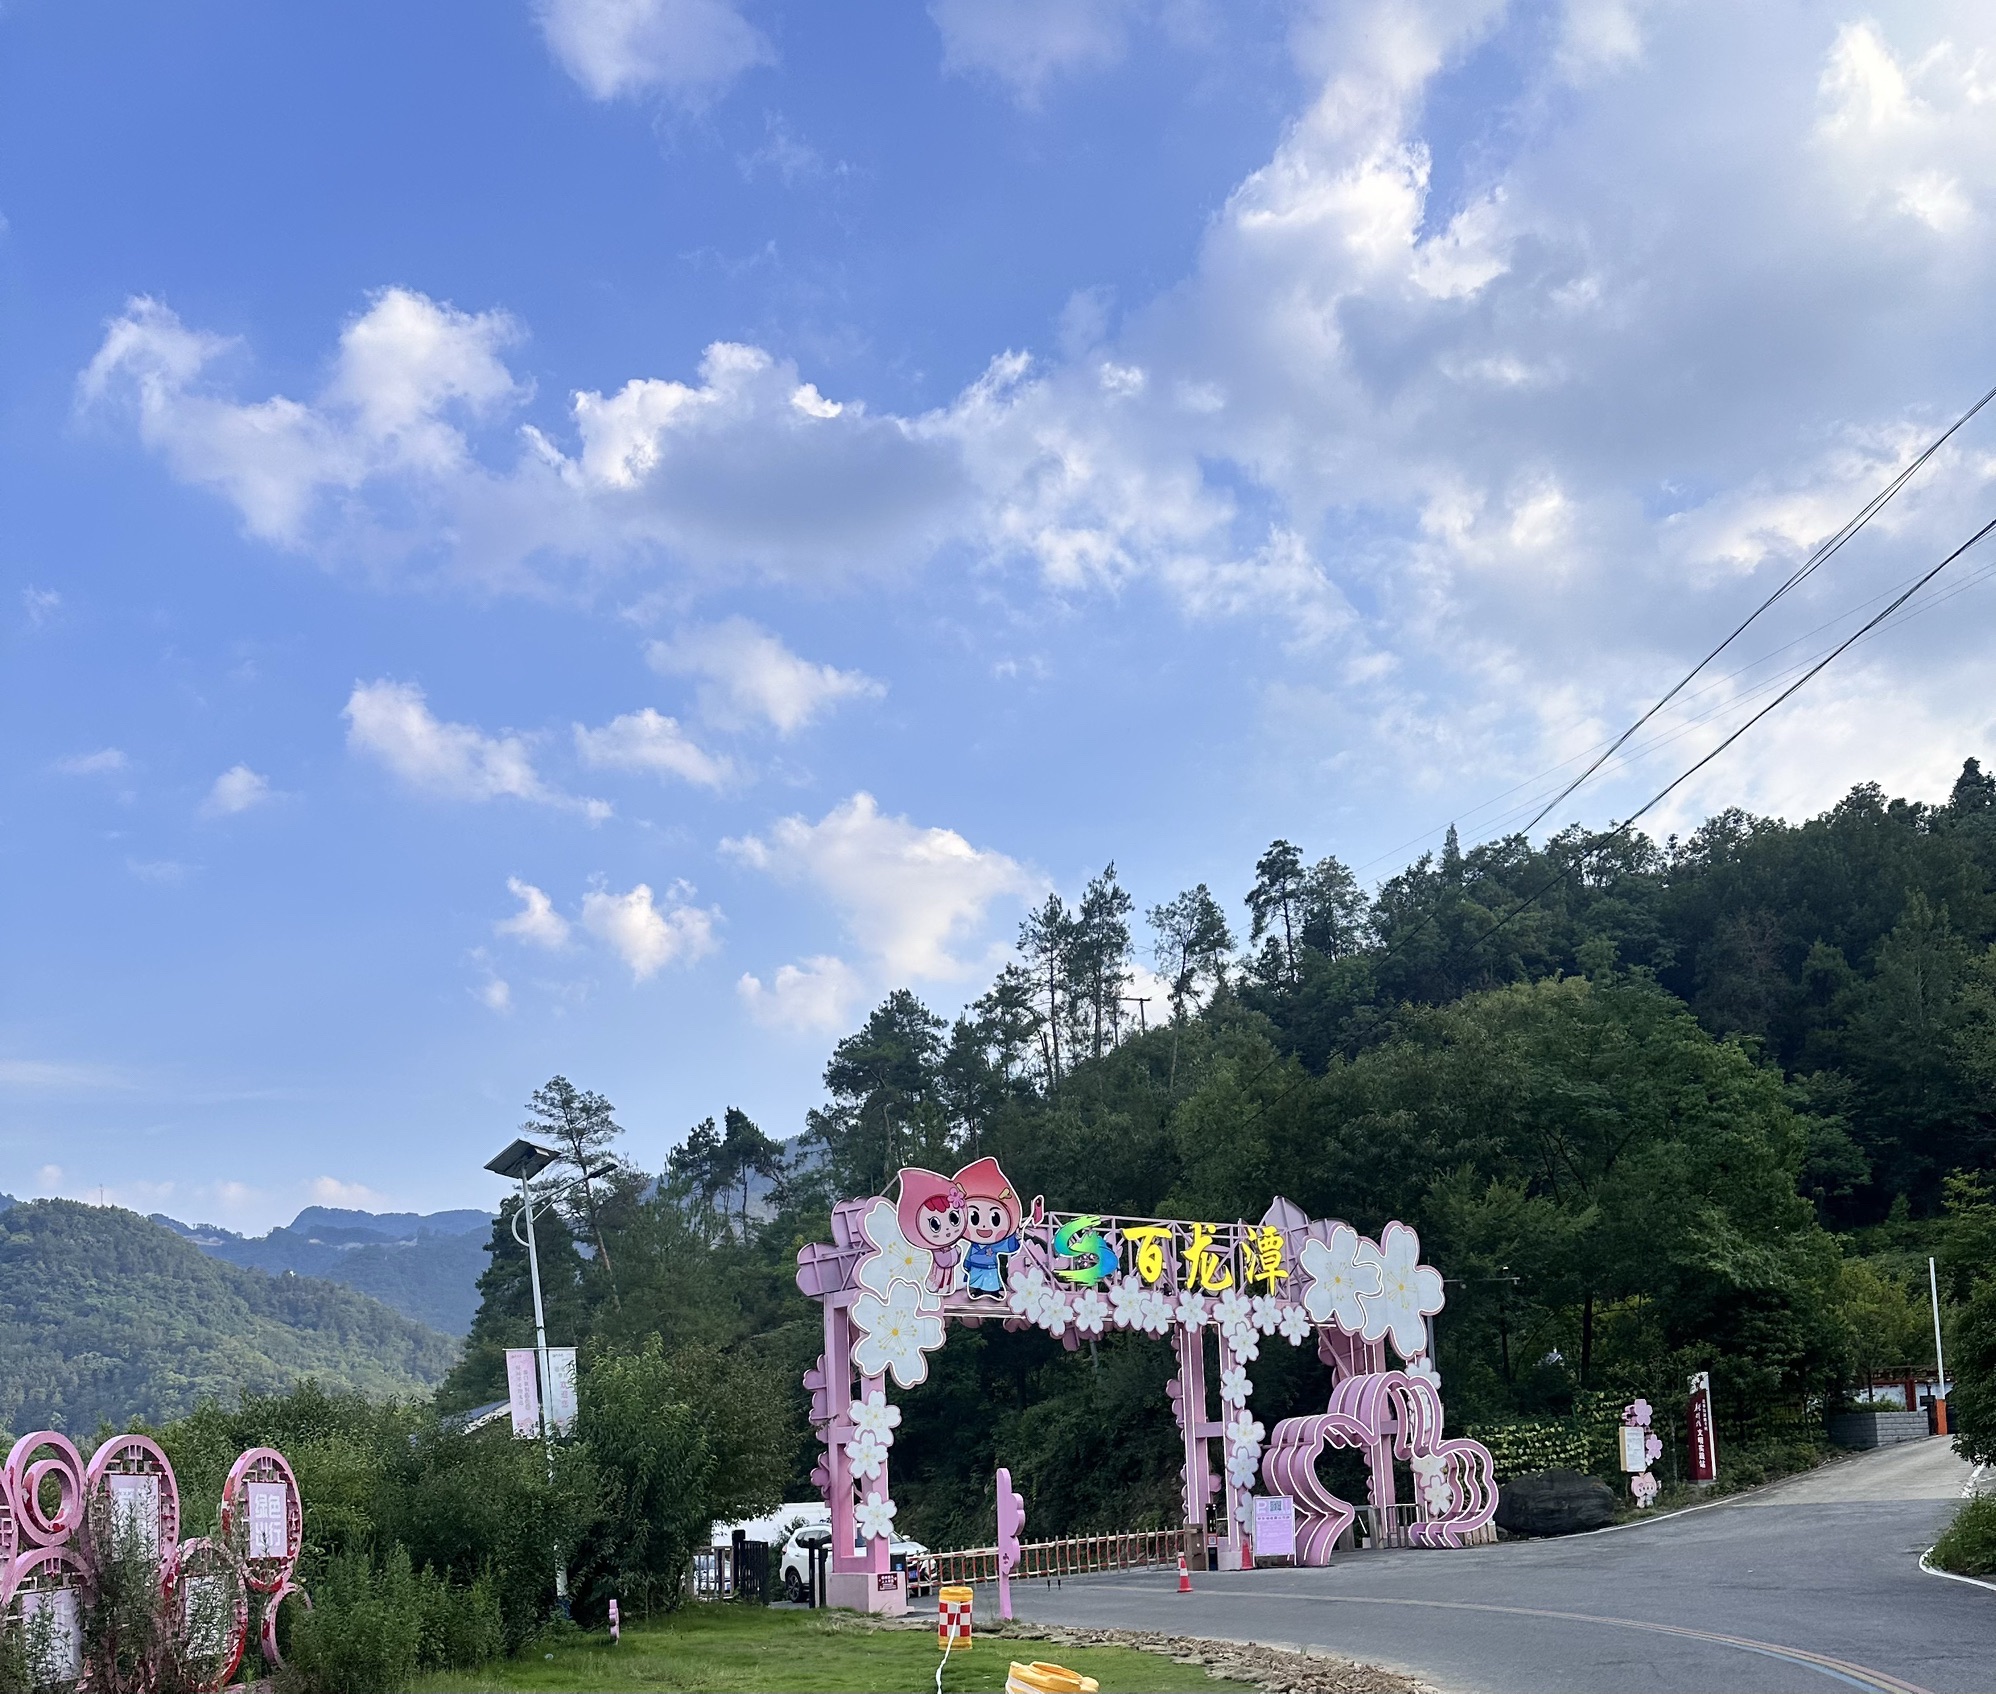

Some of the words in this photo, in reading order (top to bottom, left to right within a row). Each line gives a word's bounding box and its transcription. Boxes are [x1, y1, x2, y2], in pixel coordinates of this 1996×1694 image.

[1121, 1222, 1289, 1296] 百龙潭
[255, 1494, 281, 1518] 绿色
[255, 1522, 281, 1546] 出行
